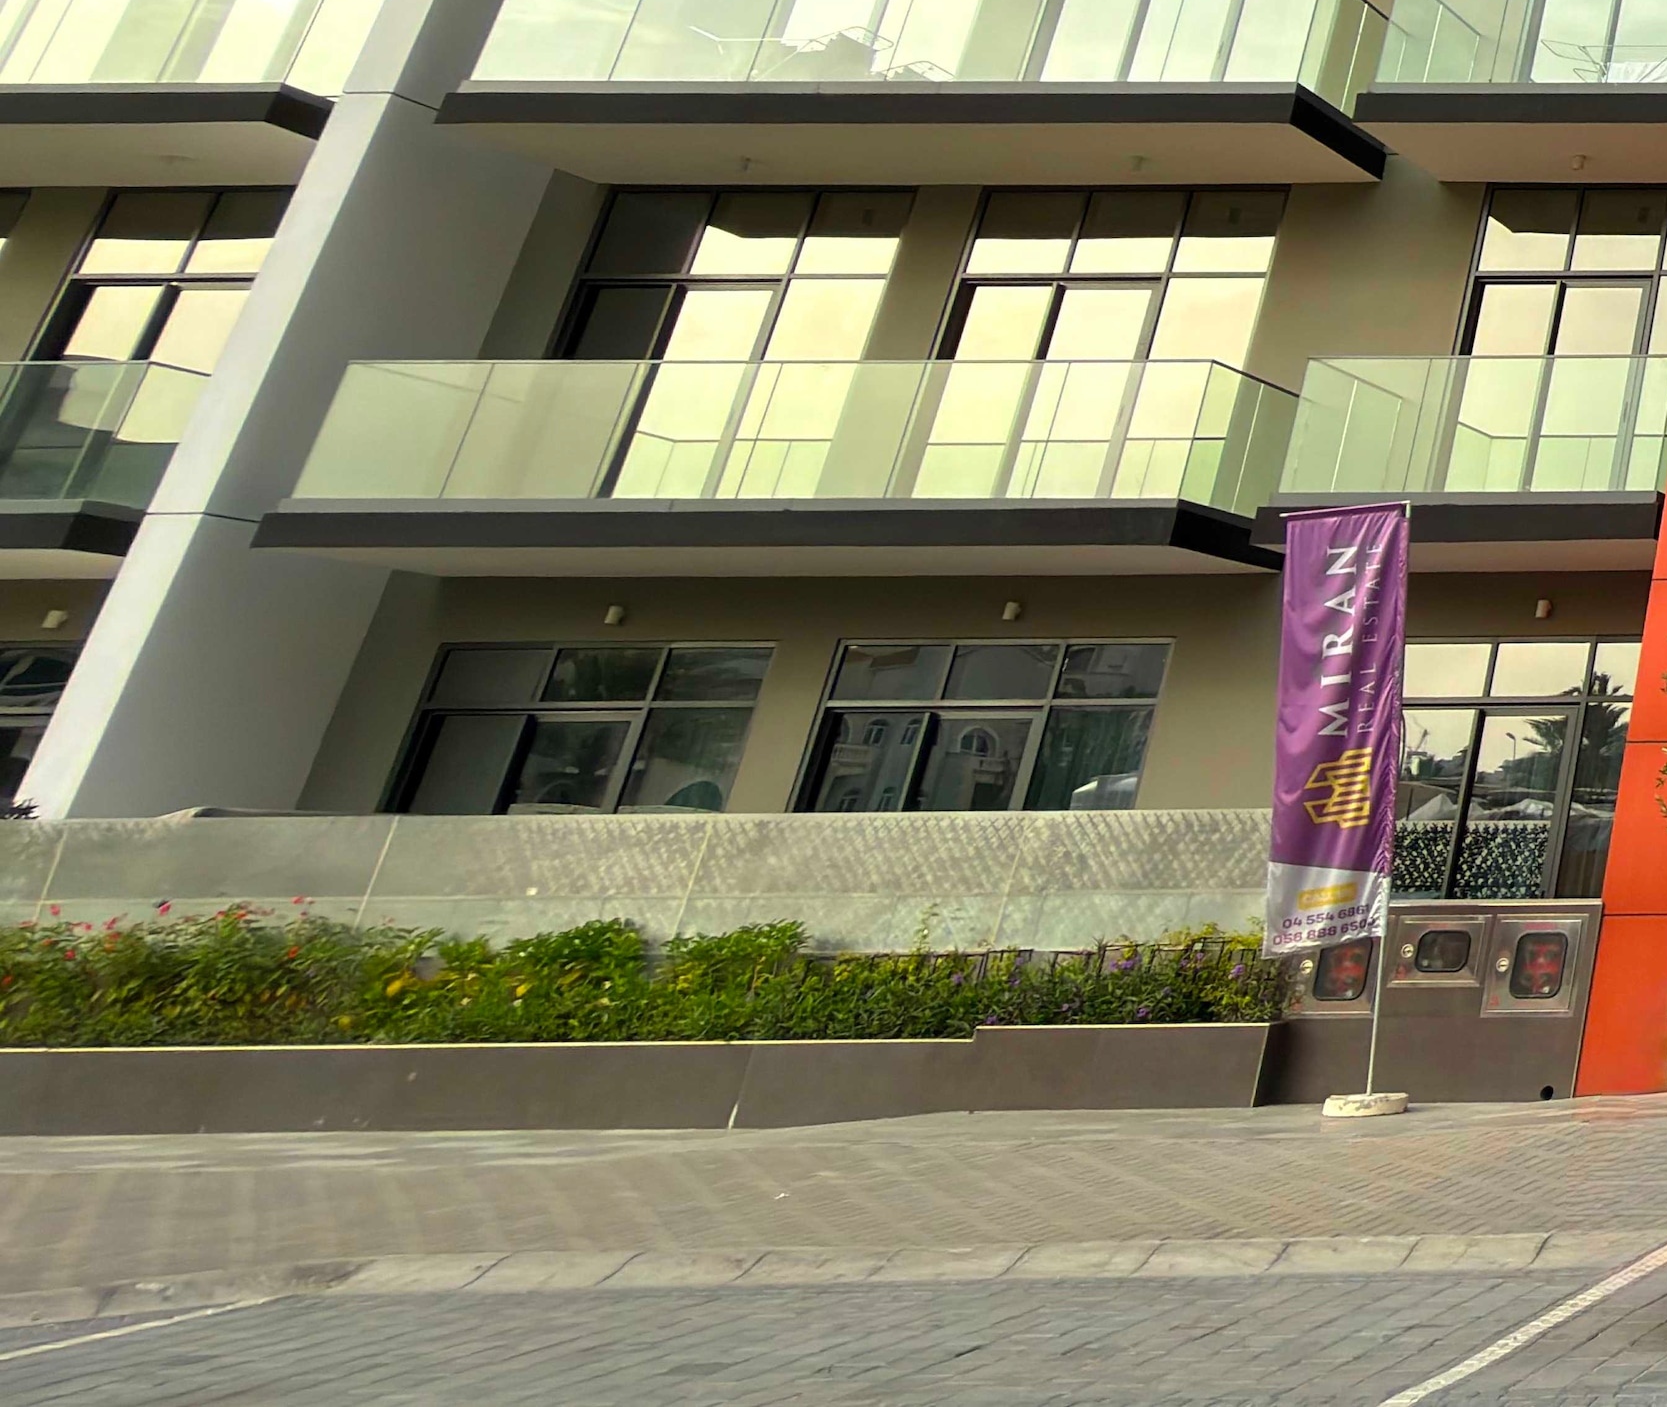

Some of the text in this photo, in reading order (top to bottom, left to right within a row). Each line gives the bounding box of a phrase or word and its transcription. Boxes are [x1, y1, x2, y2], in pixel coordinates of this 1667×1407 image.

[1317, 546, 1358, 738] MIRAN
[1357, 543, 1383, 734] REAL ESTATE
[1282, 916, 1302, 929] 04
[1306, 912, 1334, 925] 554
